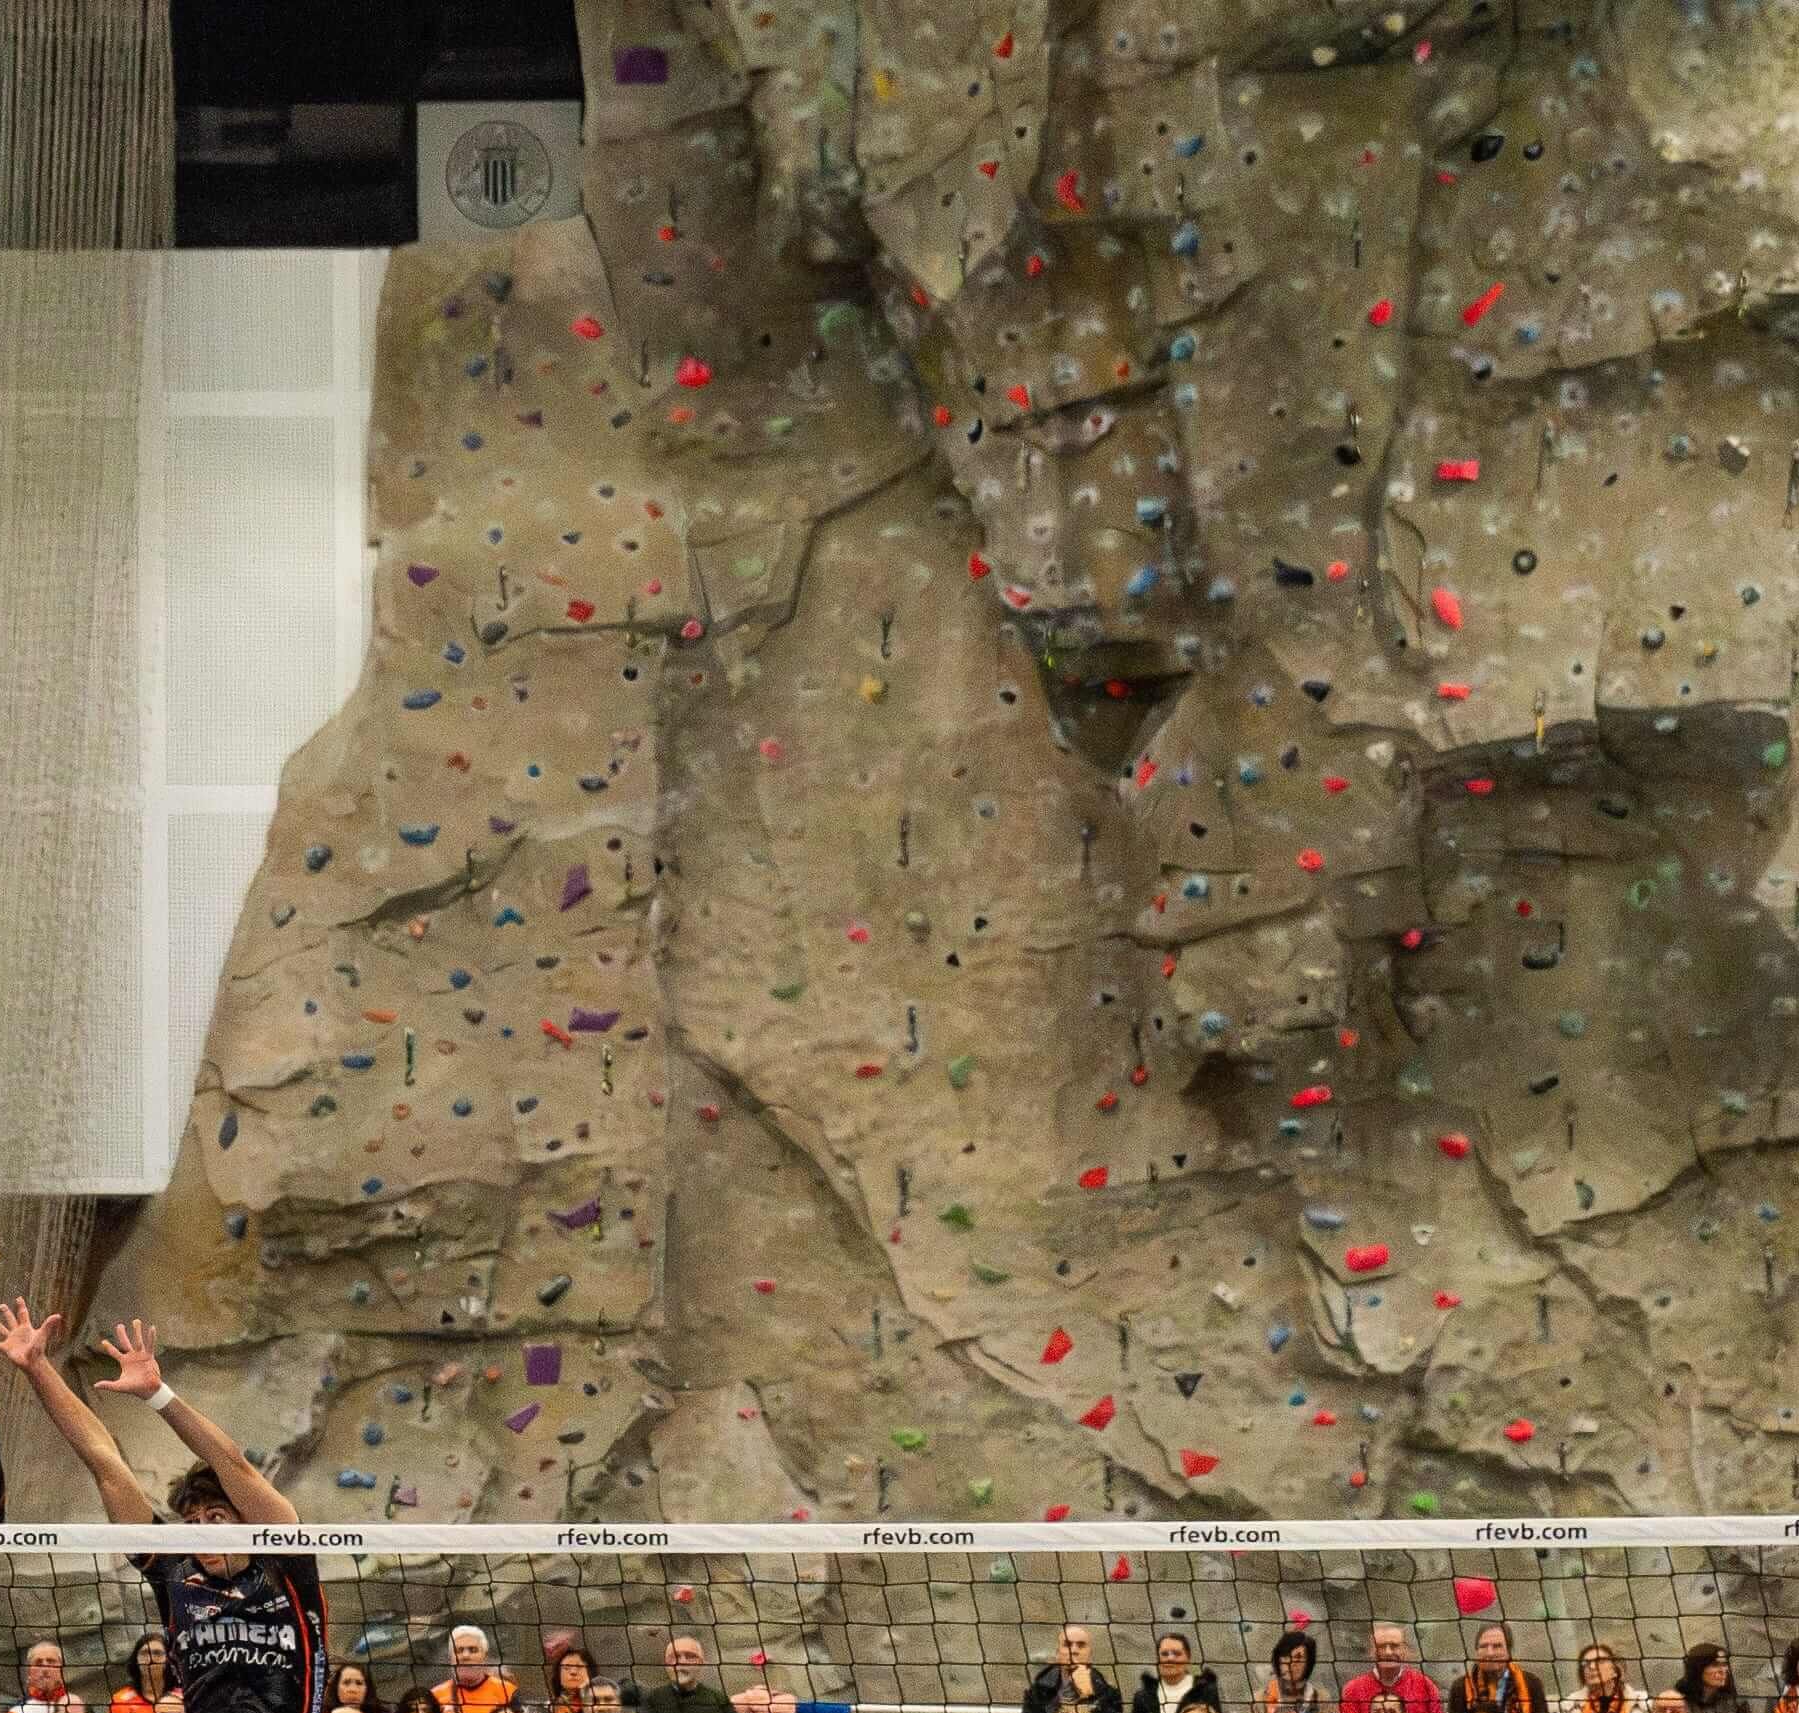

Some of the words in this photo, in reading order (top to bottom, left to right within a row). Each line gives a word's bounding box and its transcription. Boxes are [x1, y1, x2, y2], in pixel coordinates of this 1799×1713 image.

[252, 1529, 364, 1547] rfevb.com
[557, 1528, 669, 1546] rfevb.com
[862, 1527, 975, 1546] rfevb.com
[1169, 1526, 1281, 1545] rfevb.com
[1475, 1522, 1588, 1541] rfevb.com
